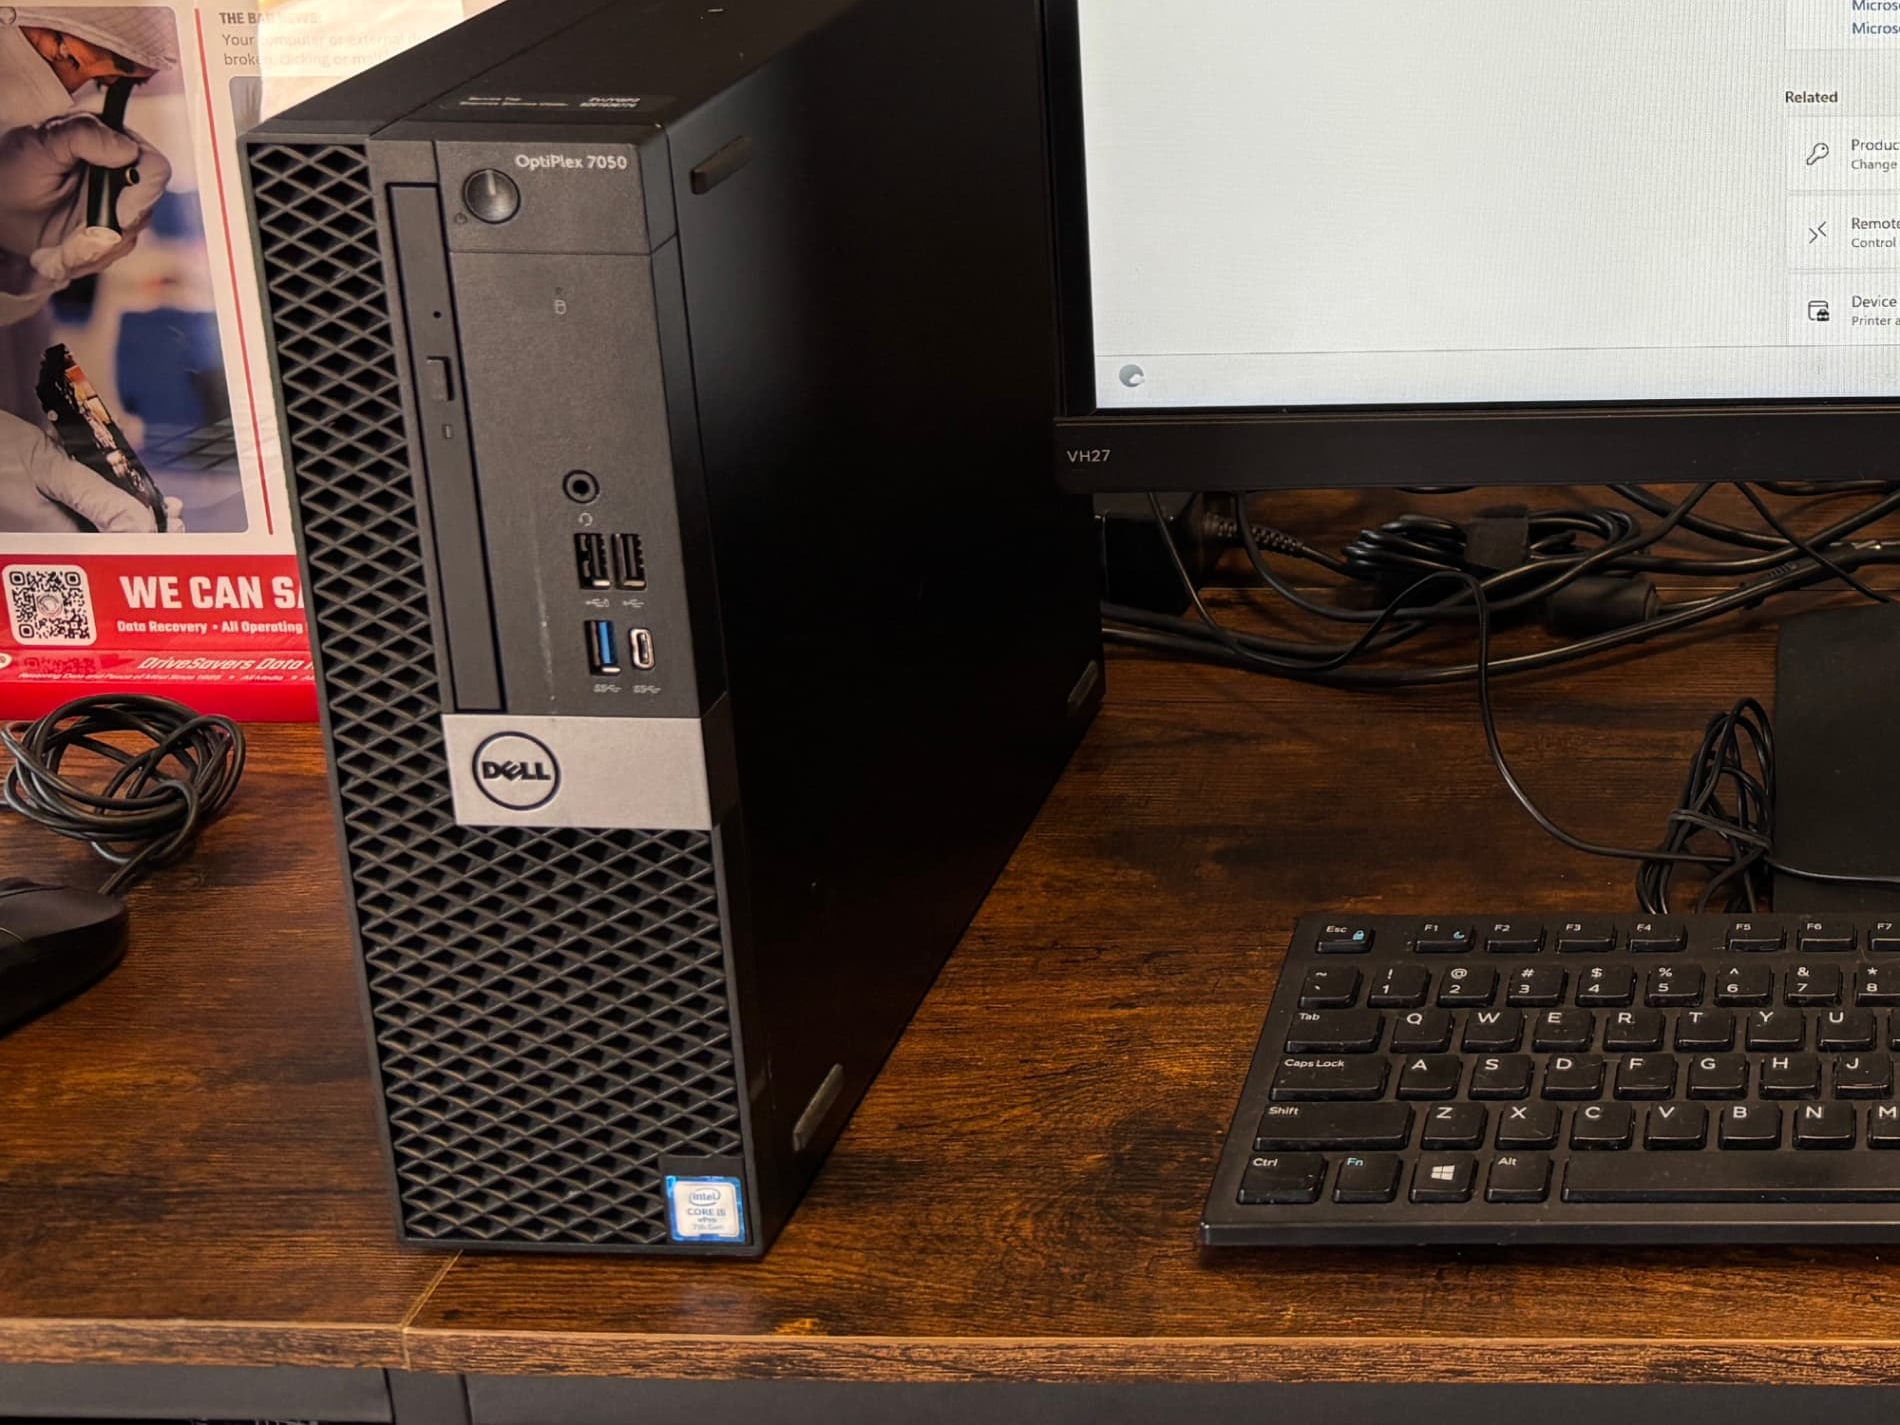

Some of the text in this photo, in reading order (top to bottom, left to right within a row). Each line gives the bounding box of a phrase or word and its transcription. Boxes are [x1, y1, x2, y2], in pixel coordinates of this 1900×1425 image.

[219, 11, 245, 25] THE
[222, 33, 256, 48] Your
[1784, 90, 1839, 104] Related
[514, 153, 628, 172] OptiPlex 7050
[1850, 158, 1898, 174] Change
[1066, 448, 1111, 463] VH27
[119, 575, 183, 609] WE
[189, 575, 264, 609] CAN
[117, 620, 208, 635] Data Recovery
[221, 620, 303, 635] All Operating
[137, 656, 302, 671] DriveSavers Data
[481, 759, 552, 782] DELL
[1325, 925, 1347, 934] Esc
[1424, 923, 1439, 932] F1
[1299, 1012, 1320, 1021] Tab
[1406, 1012, 1423, 1025] Q
[1477, 1012, 1501, 1024] W
[1284, 1058, 1345, 1069] Caps Lock
[1268, 1106, 1299, 1116] Shift
[1252, 1157, 1278, 1167] Ctrl
